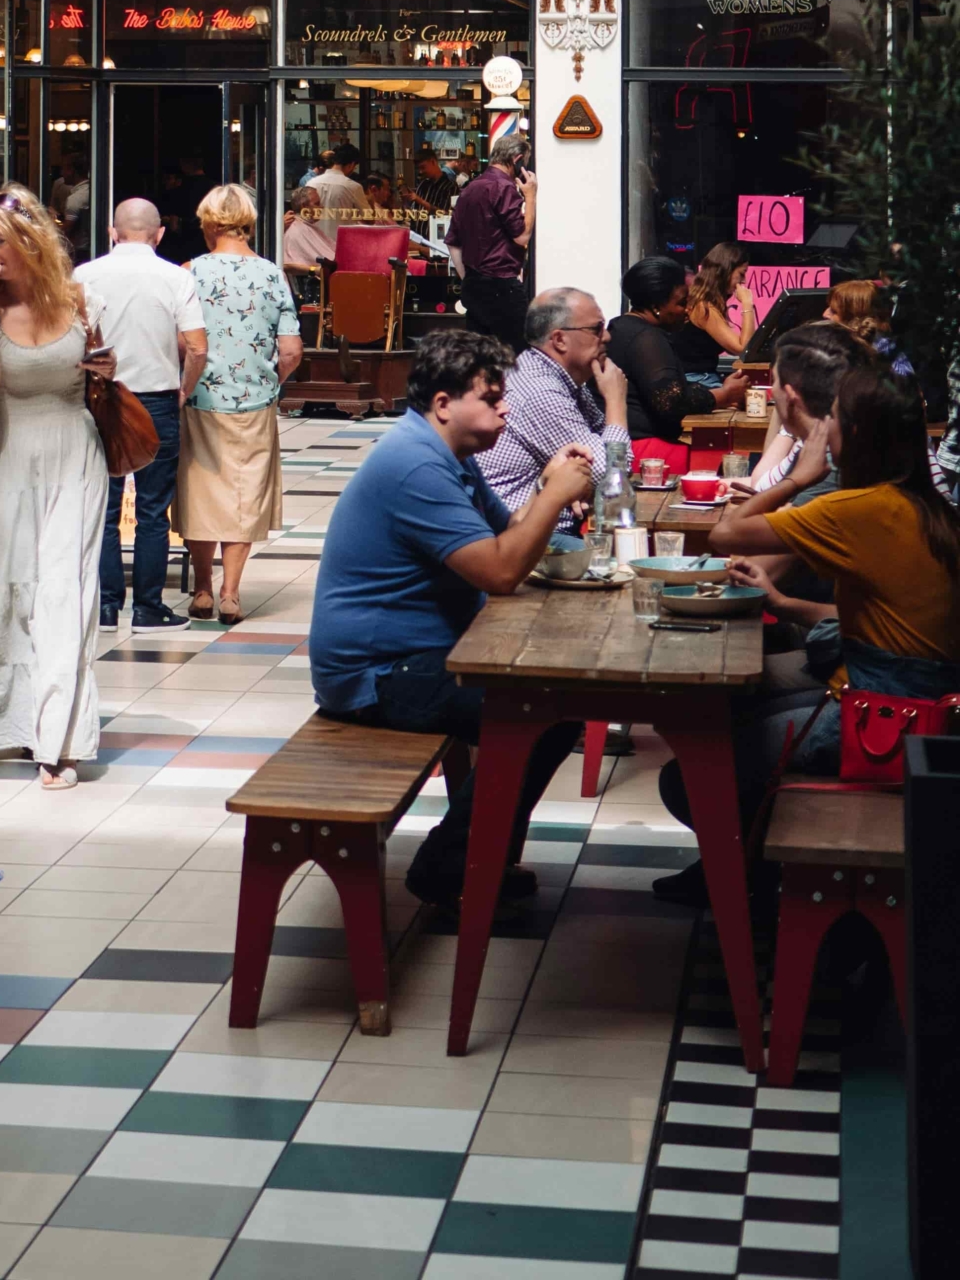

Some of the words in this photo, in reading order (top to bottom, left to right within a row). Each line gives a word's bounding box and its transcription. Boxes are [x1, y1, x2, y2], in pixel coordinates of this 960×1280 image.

[123, 9, 149, 28] The
[155, 7, 203, 30] Baba's
[210, 9, 256, 30] House
[301, 23, 388, 43] Scoundrels
[393, 24, 416, 43] &
[420, 23, 507, 43] Gentlemen
[300, 207, 428, 222] GENTLEMENS
[742, 201, 790, 236] £10
